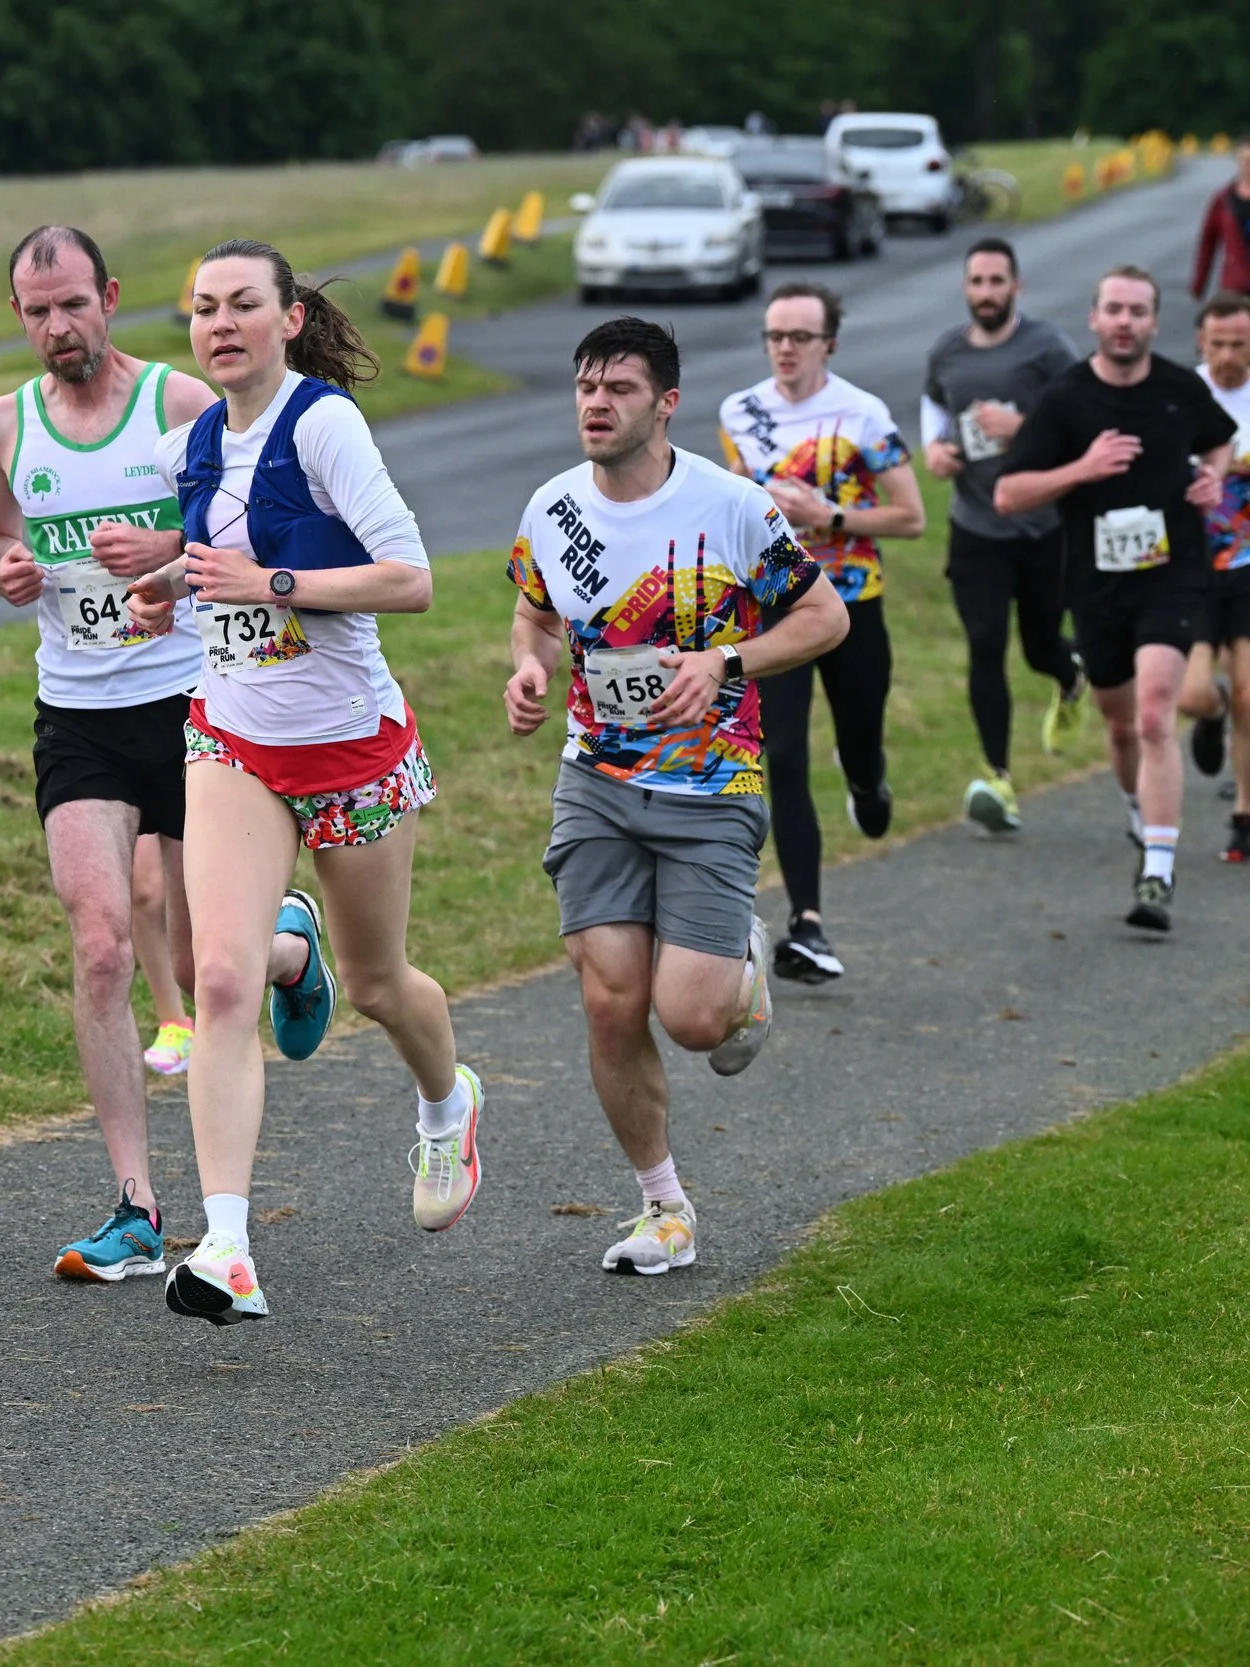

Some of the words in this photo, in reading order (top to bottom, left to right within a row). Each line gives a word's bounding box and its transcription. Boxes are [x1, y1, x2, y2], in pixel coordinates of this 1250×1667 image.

[124, 465, 159, 477] LEYDE
[564, 493, 582, 516] DUBLIN
[42, 508, 160, 554] RAHY
[546, 499, 606, 564] PRIDE
[560, 544, 609, 597] RUN
[573, 585, 593, 604] 2024
[618, 565, 668, 625] PRIDE
[71, 627, 91, 636] PRIDE
[214, 607, 276, 645] 732
[209, 647, 229, 656] PRIDE
[220, 653, 235, 662] RUN
[606, 674, 665, 703] 158
[707, 737, 758, 769] RUN
